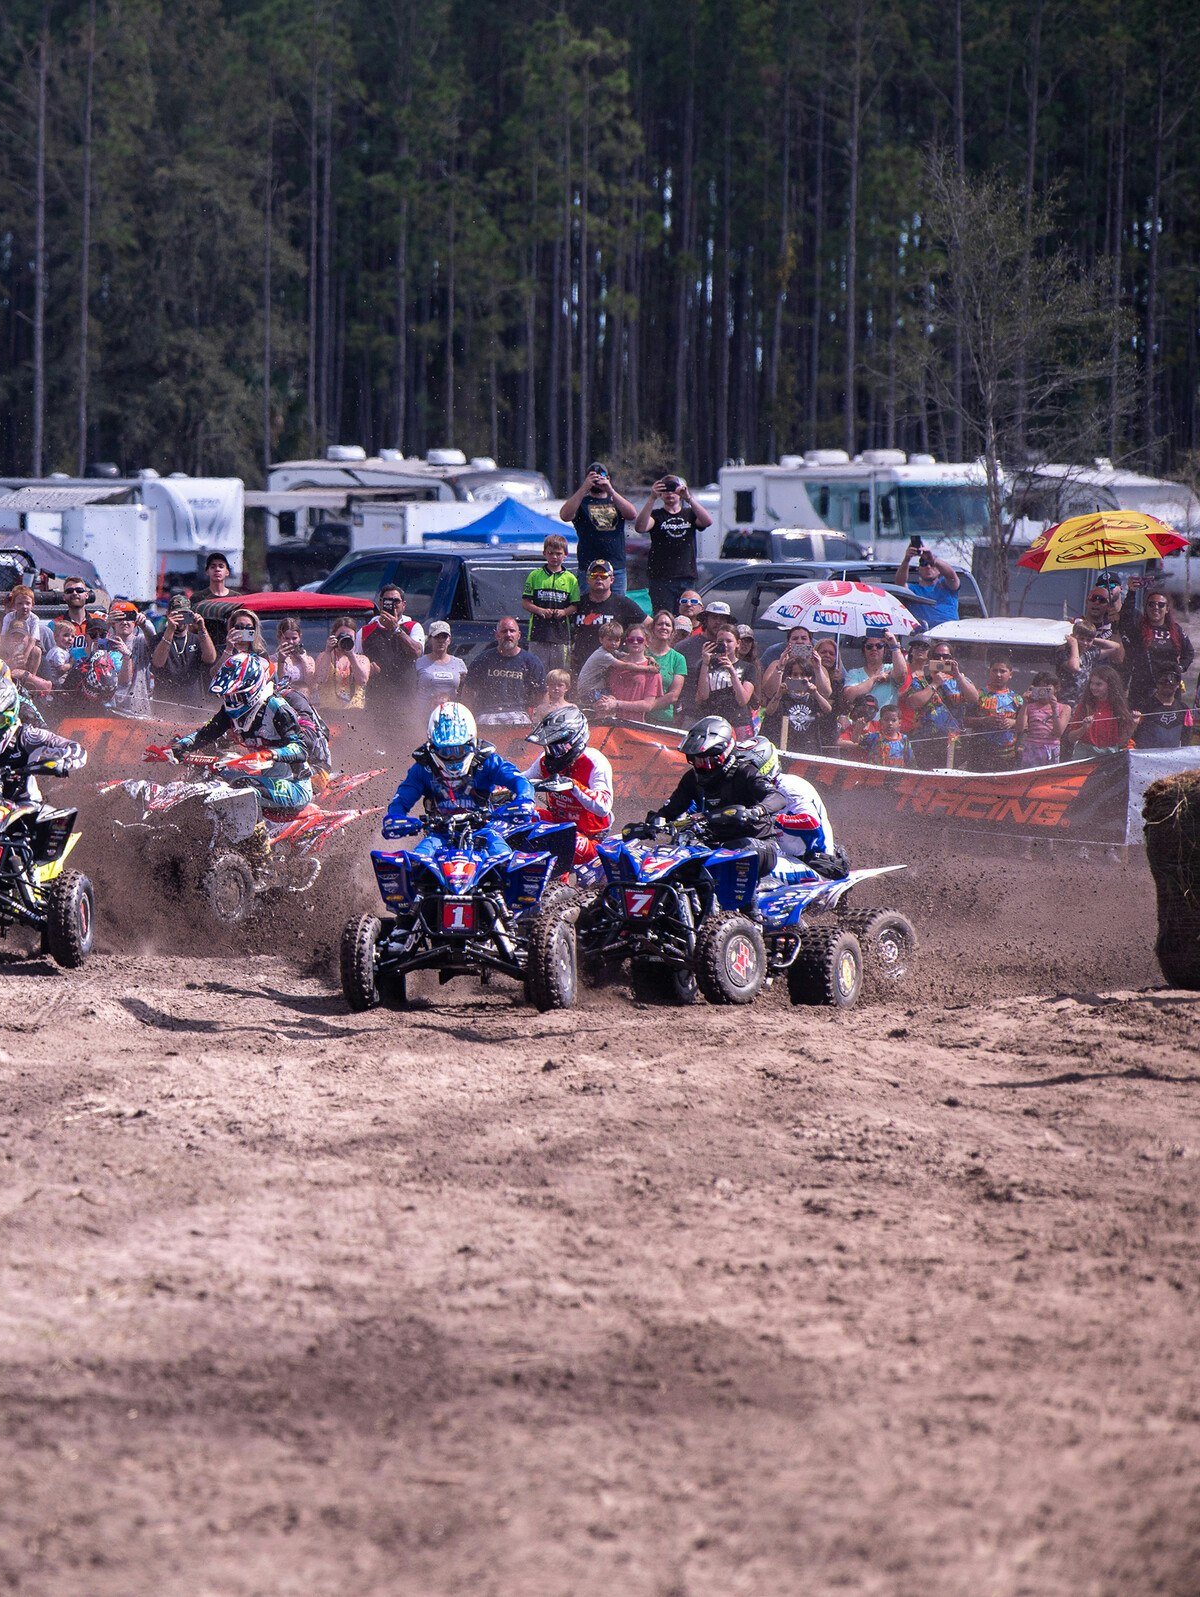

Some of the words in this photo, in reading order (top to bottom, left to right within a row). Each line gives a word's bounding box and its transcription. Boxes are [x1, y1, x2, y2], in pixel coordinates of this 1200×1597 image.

[576, 614, 614, 625] HNT
[488, 669, 523, 680] LOGGER
[896, 795, 1068, 828] RACING
[450, 861, 469, 876] 1
[630, 894, 652, 913] 7
[452, 906, 465, 928] 1
